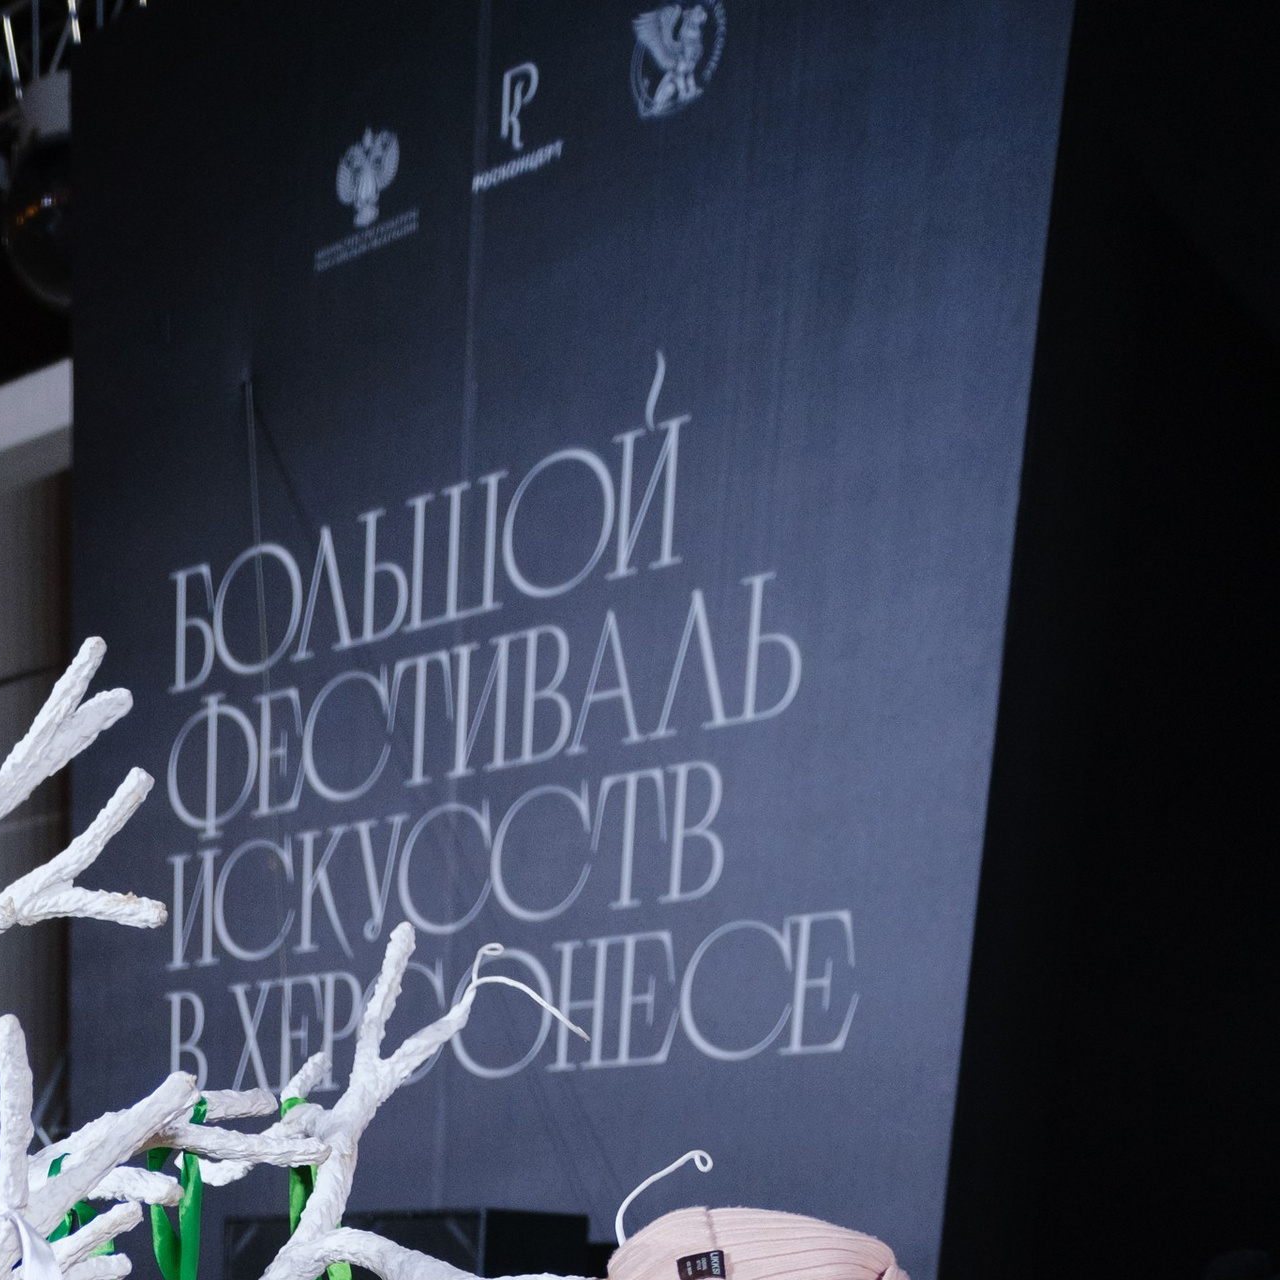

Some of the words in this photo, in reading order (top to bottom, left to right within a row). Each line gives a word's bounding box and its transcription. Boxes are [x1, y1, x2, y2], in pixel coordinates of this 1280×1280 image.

[169, 349, 691, 694] БОЛЬШОЙ
[167, 571, 803, 841] ФЕСТИВАЛЬ
[167, 760, 724, 971] ИСКУССТВ
[165, 990, 208, 1091] В
